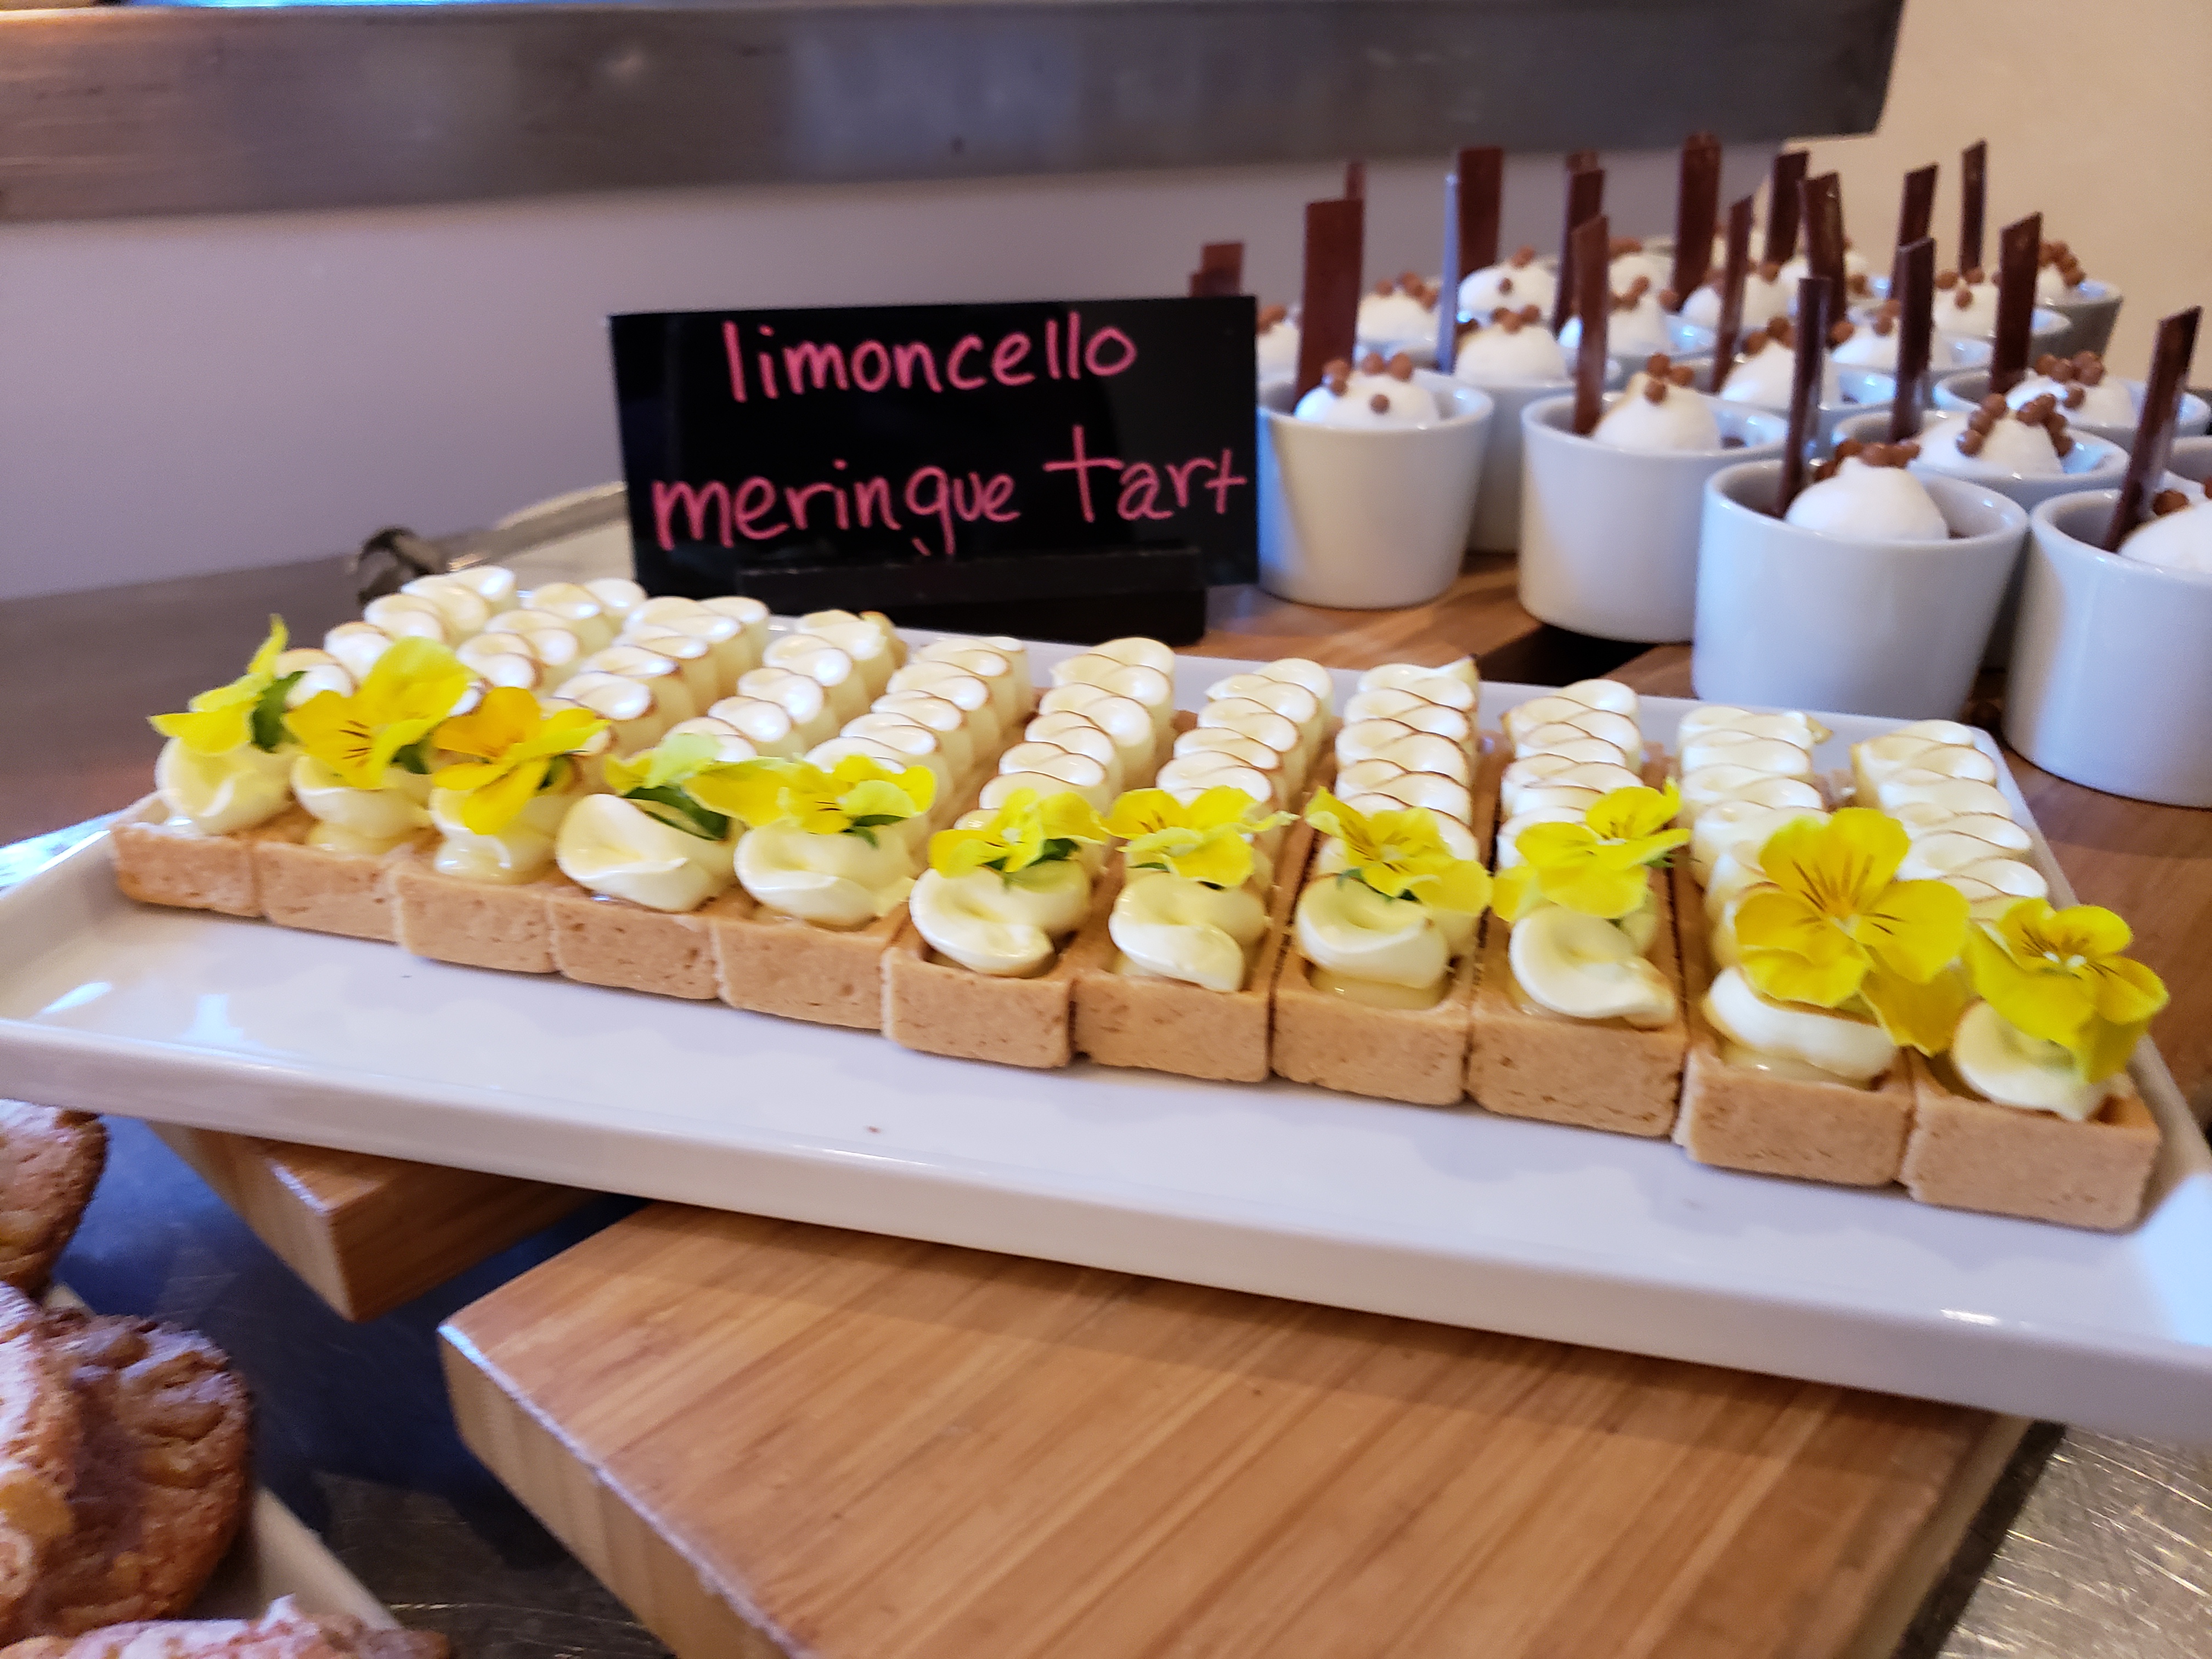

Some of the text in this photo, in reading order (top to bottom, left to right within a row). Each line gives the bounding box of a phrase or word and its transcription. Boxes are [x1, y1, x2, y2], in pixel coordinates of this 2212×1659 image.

[723, 312, 1137, 402] limoncello
[652, 424, 1247, 555] meringue tart
